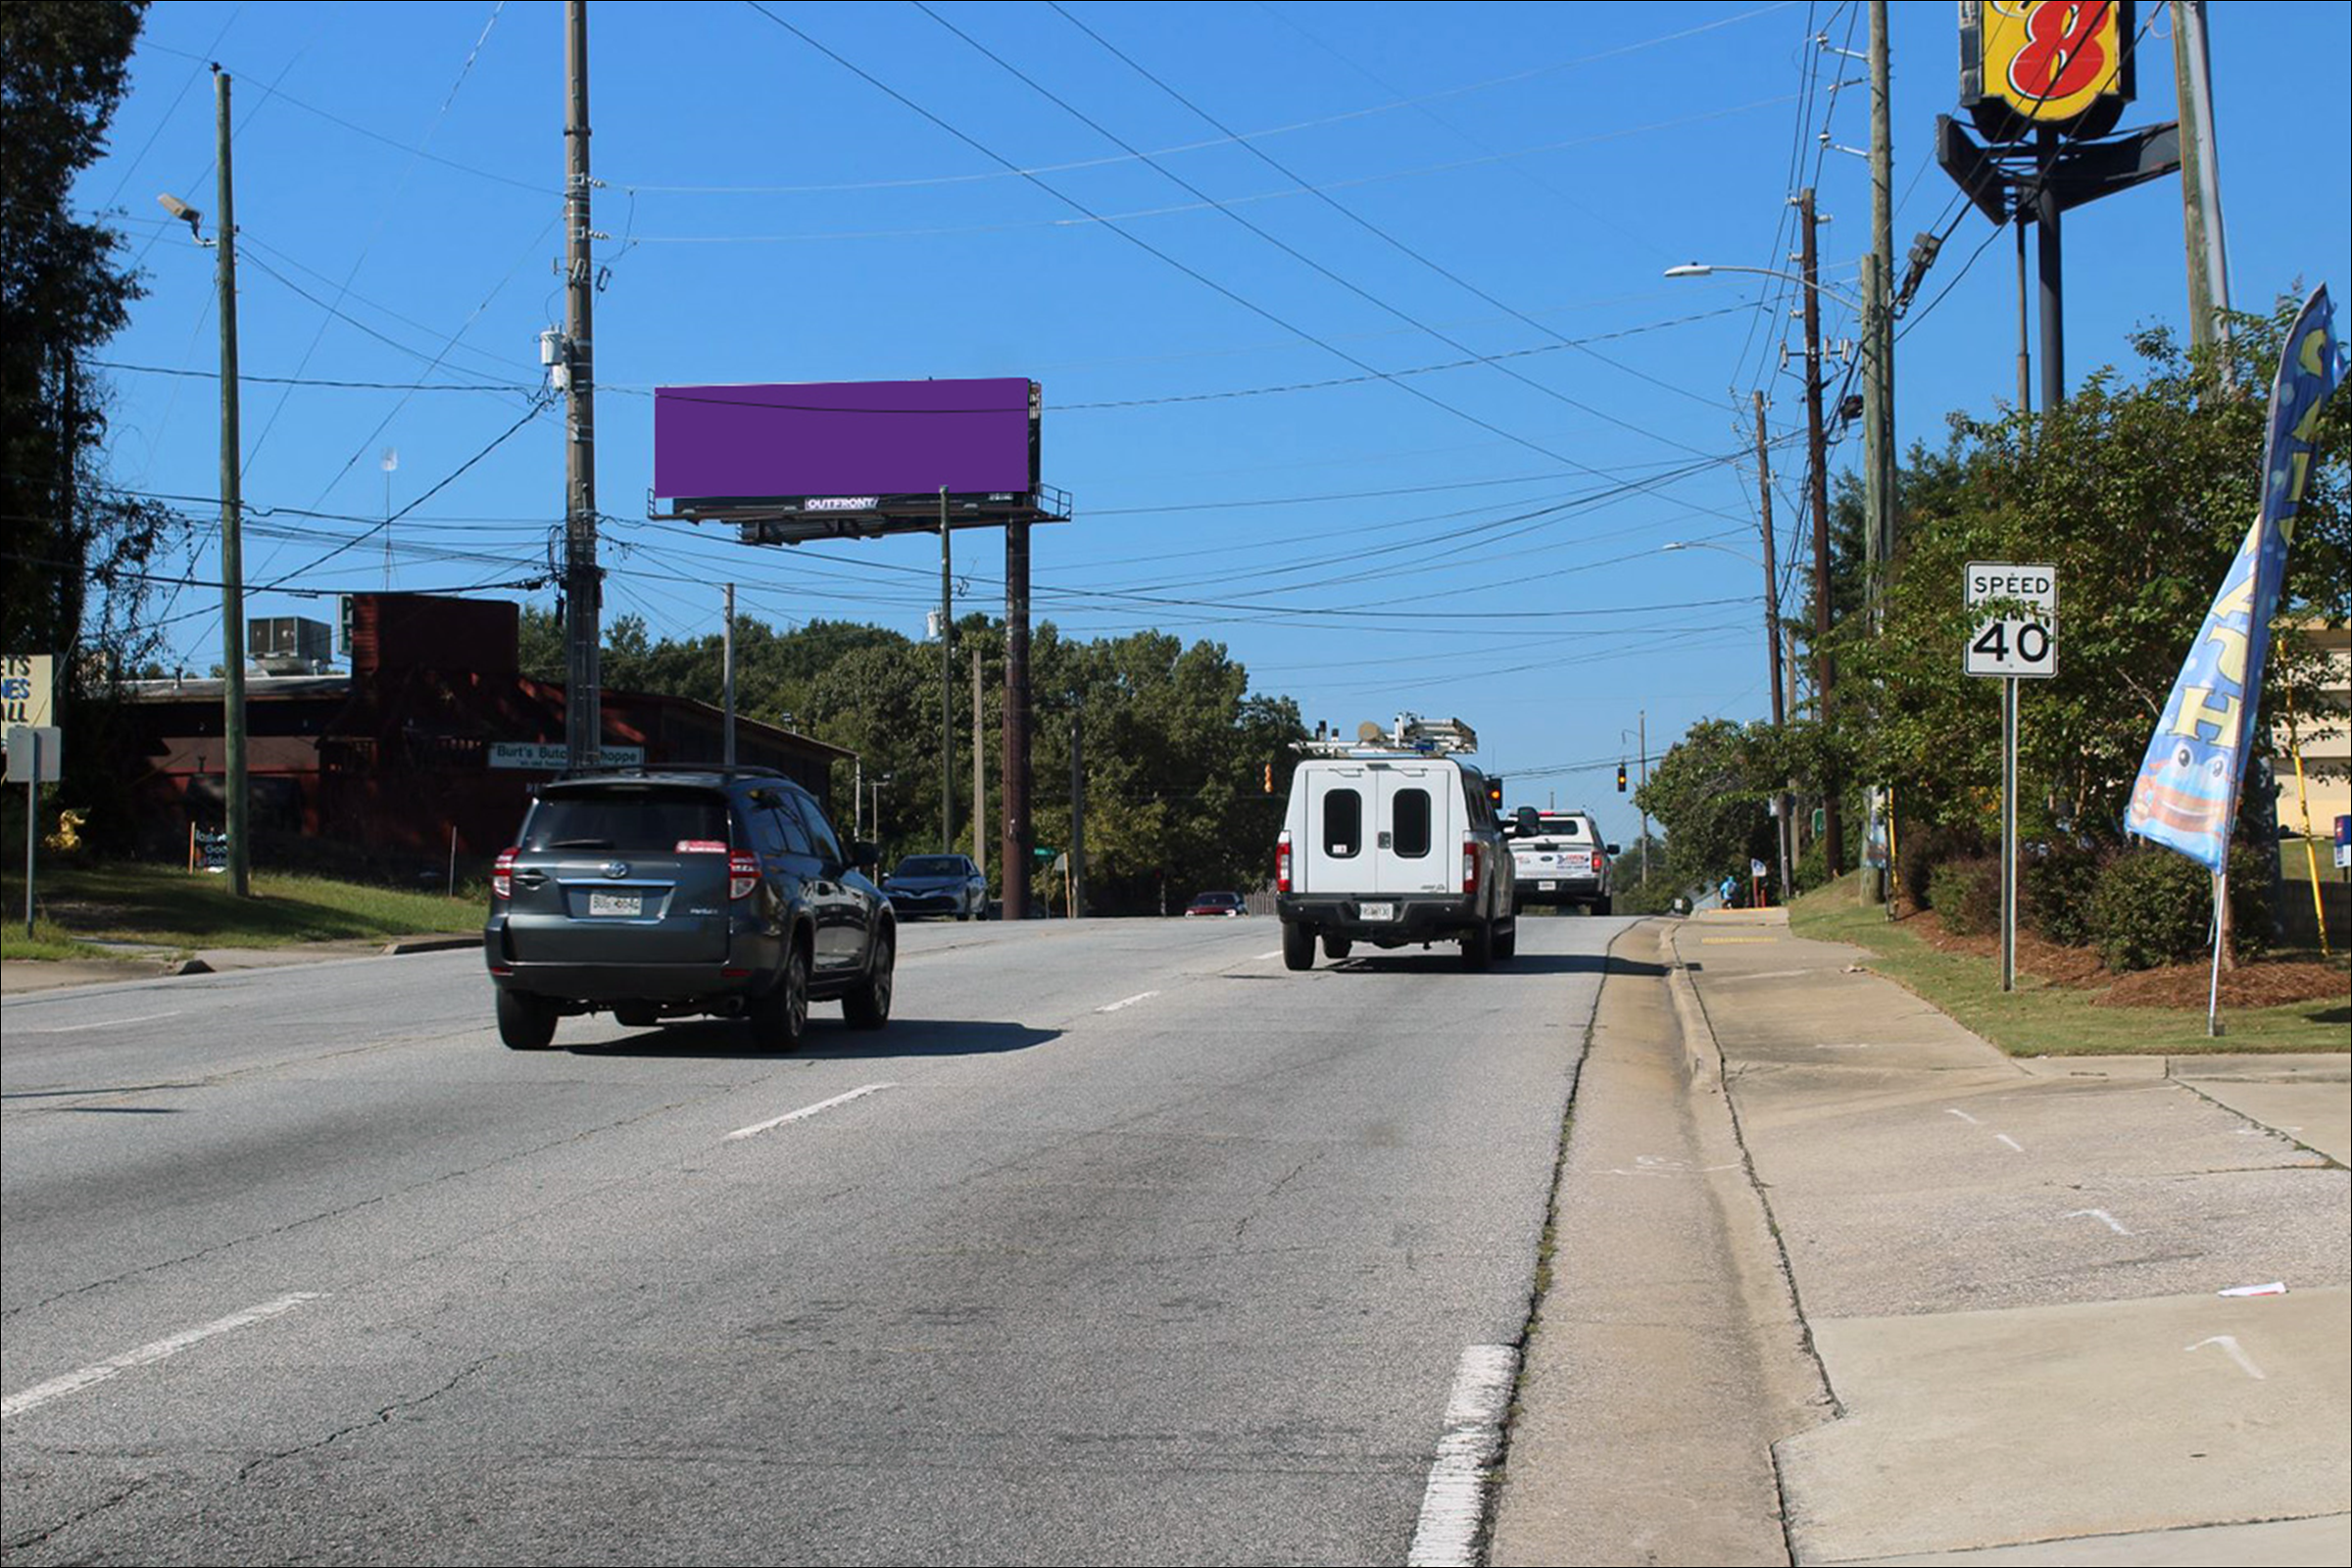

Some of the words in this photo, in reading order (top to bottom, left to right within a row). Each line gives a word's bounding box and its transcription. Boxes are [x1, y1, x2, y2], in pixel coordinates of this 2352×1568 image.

[2007, 1, 2110, 101] 8
[1974, 575, 2050, 594] SPEED
[1973, 622, 2050, 663] 40
[497, 745, 534, 758] Burt's
